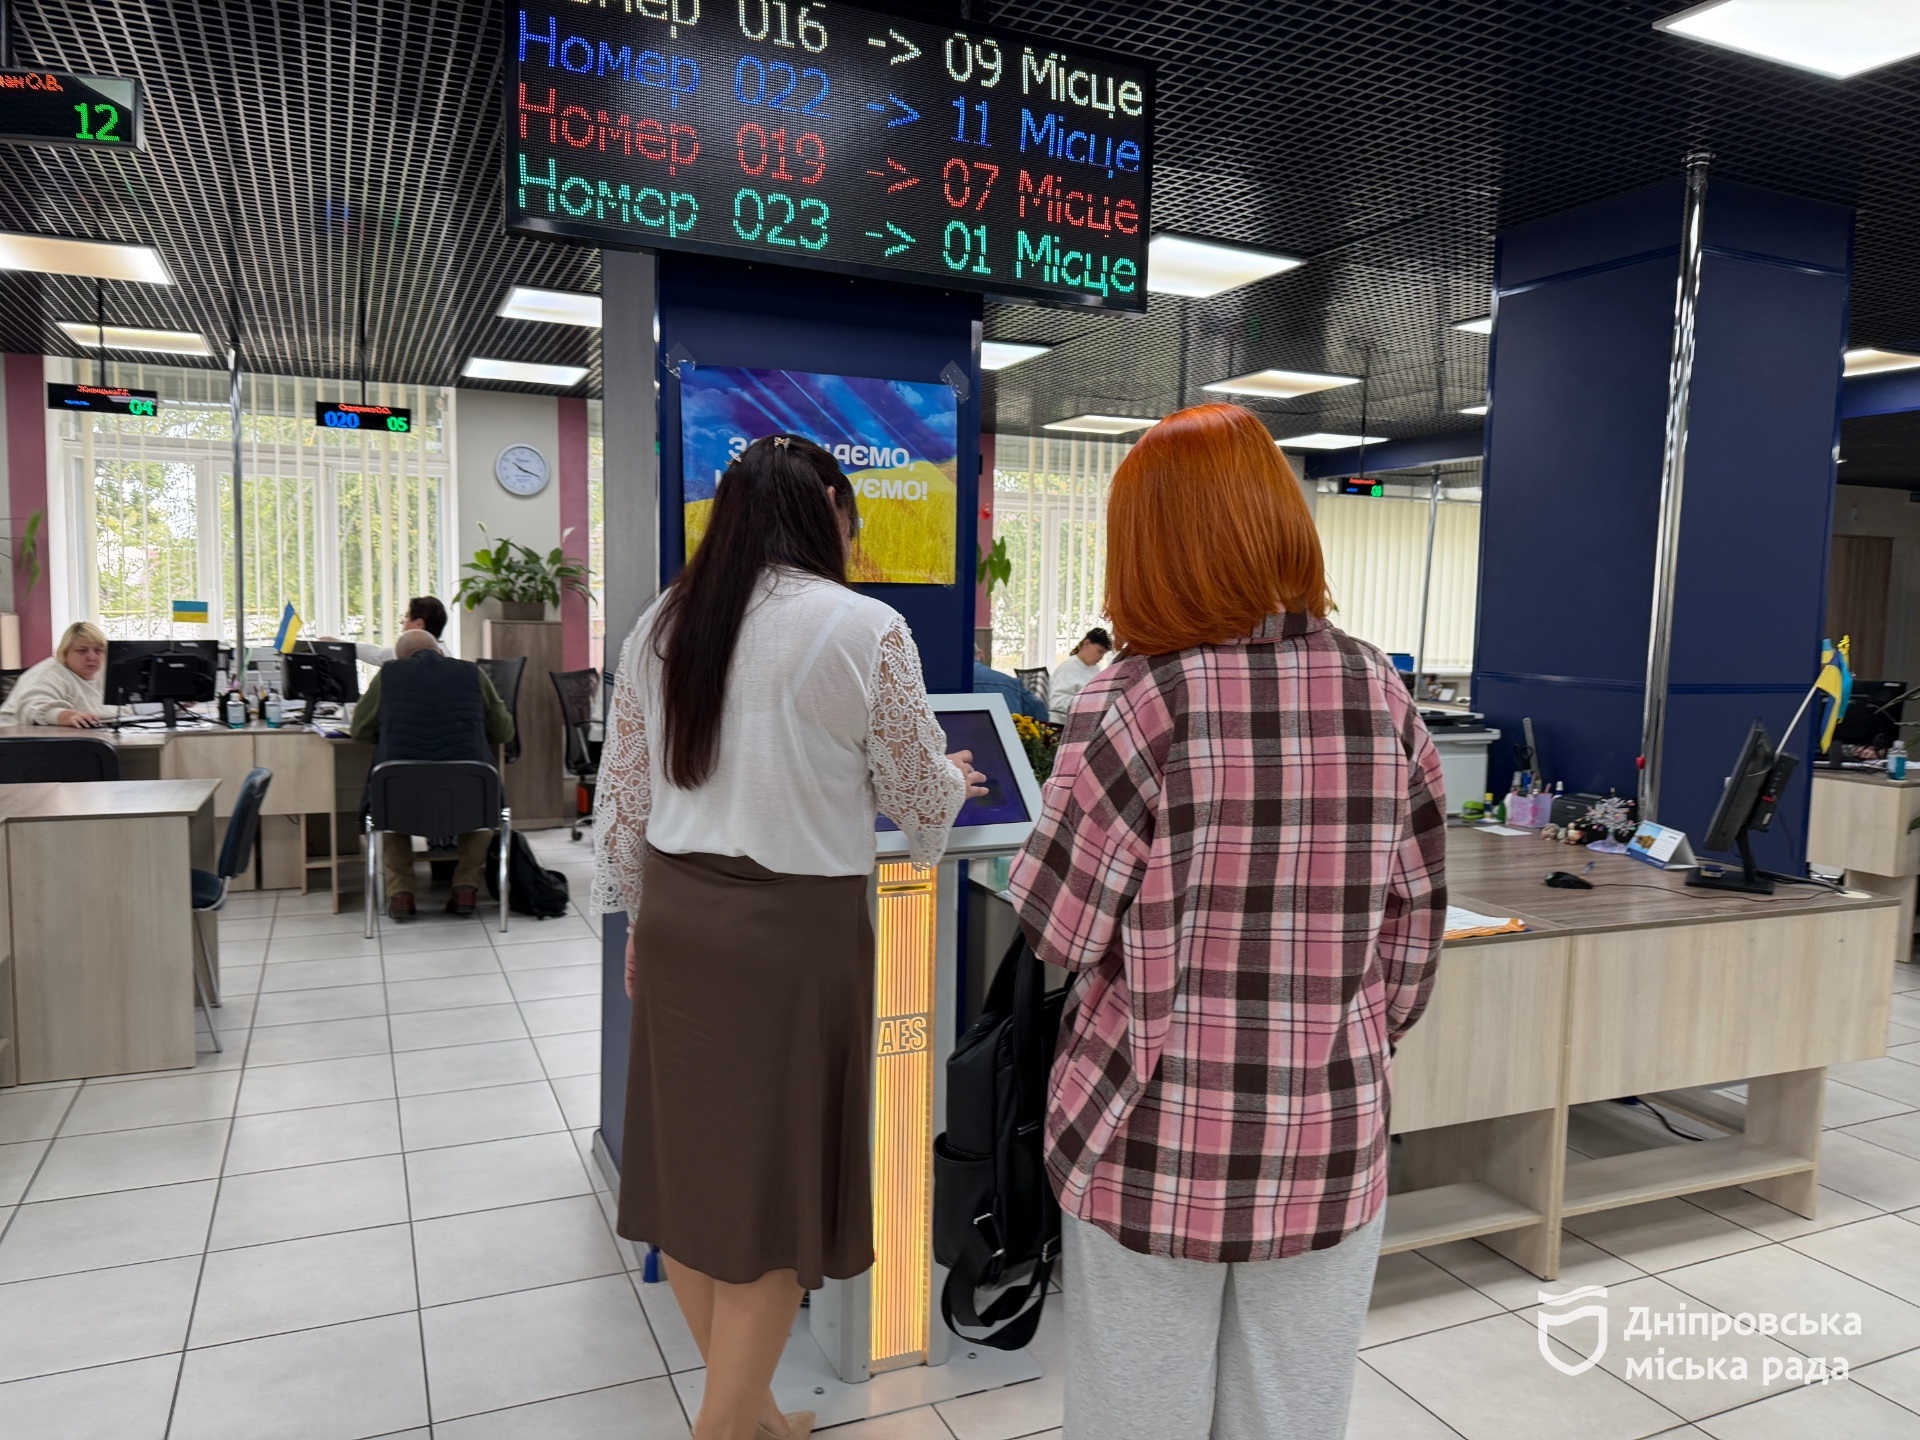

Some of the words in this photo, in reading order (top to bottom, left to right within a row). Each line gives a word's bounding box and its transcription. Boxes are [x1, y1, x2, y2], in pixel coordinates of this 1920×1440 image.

[519, 10, 701, 108] Номер
[734, 55, 830, 119] 022
[951, 95, 992, 147] 11
[1019, 108, 1141, 178] Місце
[739, 0, 828, 53] 016
[945, 32, 1001, 88] 09
[1021, 47, 1142, 118] Місце
[74, 102, 120, 142] 12
[518, 83, 699, 176] Номер
[737, 123, 827, 184] 019
[943, 158, 999, 211] 07
[1018, 169, 1139, 238] Місце
[733, 187, 830, 250] 023
[943, 220, 991, 275] 01
[1016, 230, 1137, 297] Місце
[129, 398, 153, 416] 04
[324, 410, 360, 429] 020
[387, 415, 408, 432] 05
[877, 1017, 927, 1055] AES
